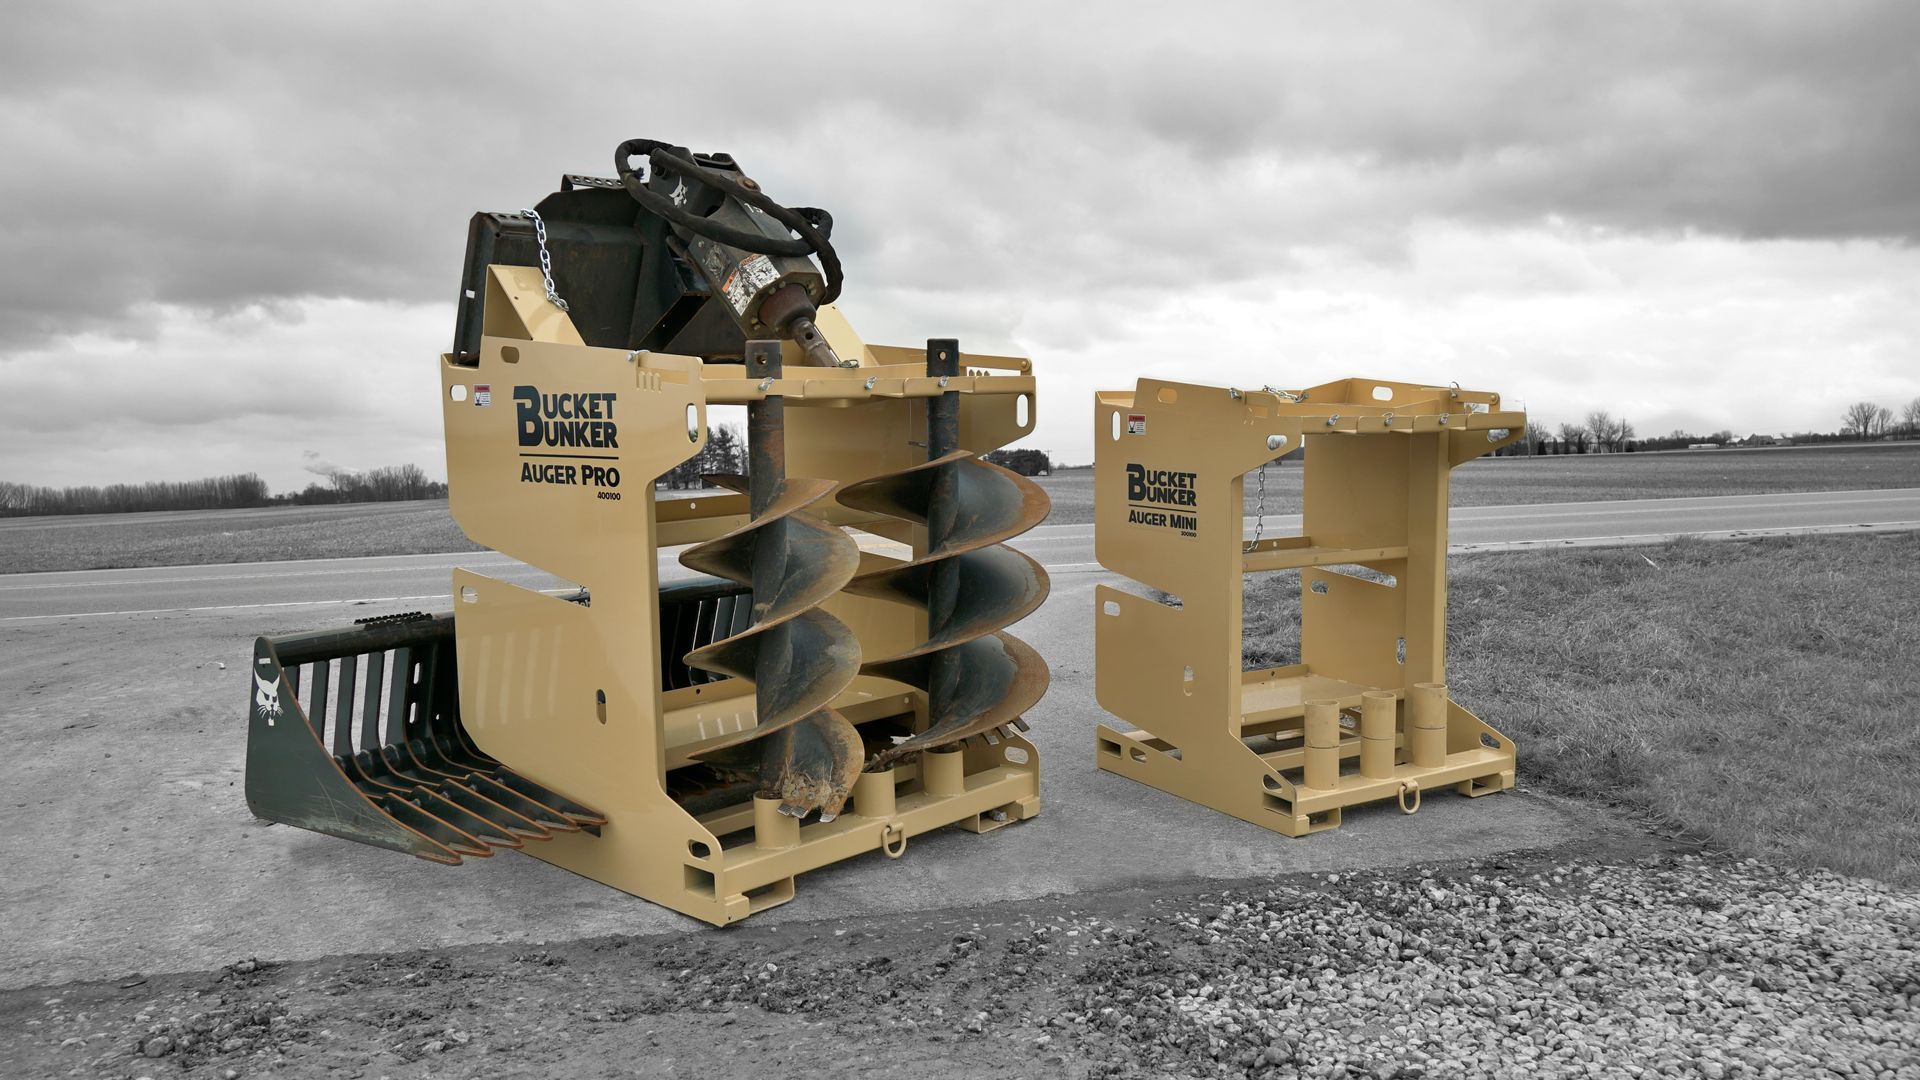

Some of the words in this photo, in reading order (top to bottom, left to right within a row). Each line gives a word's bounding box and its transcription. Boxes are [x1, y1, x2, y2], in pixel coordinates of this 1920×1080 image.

[513, 385, 617, 419] BUCKET
[520, 462, 577, 485] AUGER
[581, 464, 620, 488] PRO
[1126, 463, 1197, 488] BUCKET
[597, 491, 621, 501] 400100
[1128, 509, 1167, 526] AUGER
[1170, 513, 1197, 530] MINI
